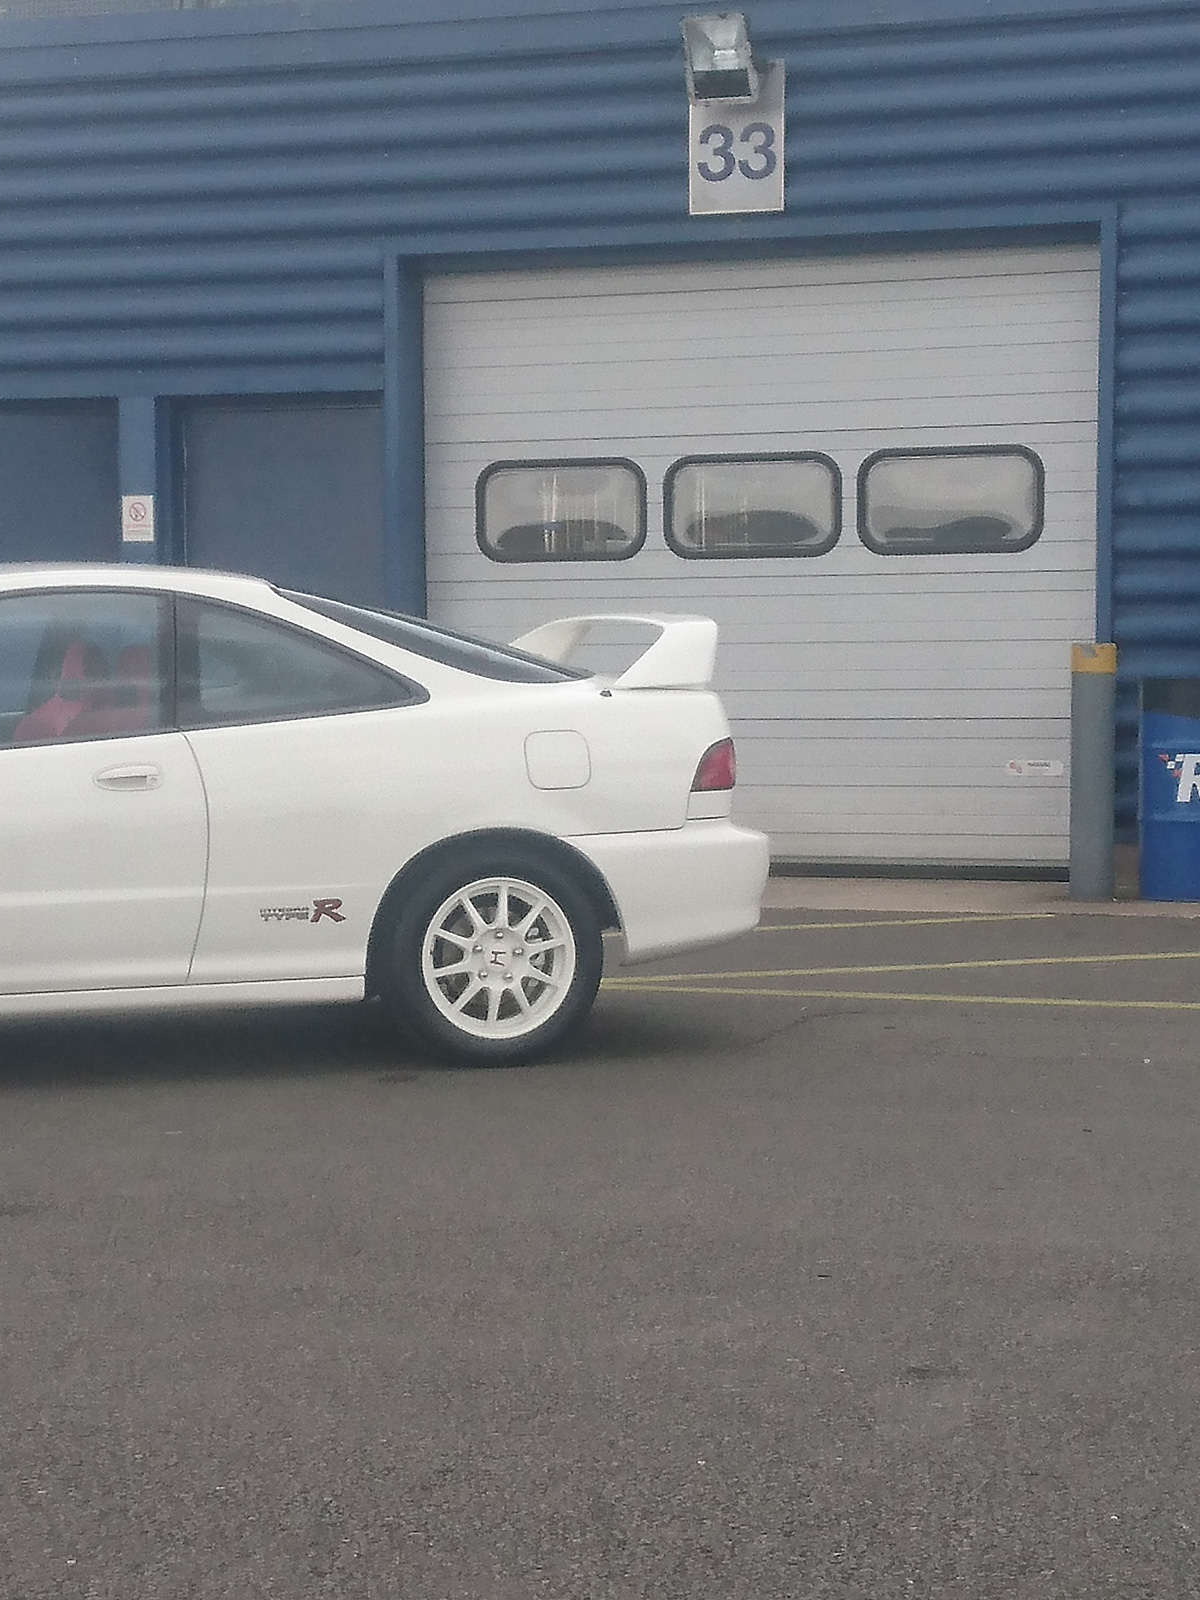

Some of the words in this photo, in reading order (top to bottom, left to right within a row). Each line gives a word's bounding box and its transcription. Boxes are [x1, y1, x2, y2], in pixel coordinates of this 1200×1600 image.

[696, 122, 776, 182] 33
[260, 912, 309, 921] TYPE
[310, 898, 346, 923] R
